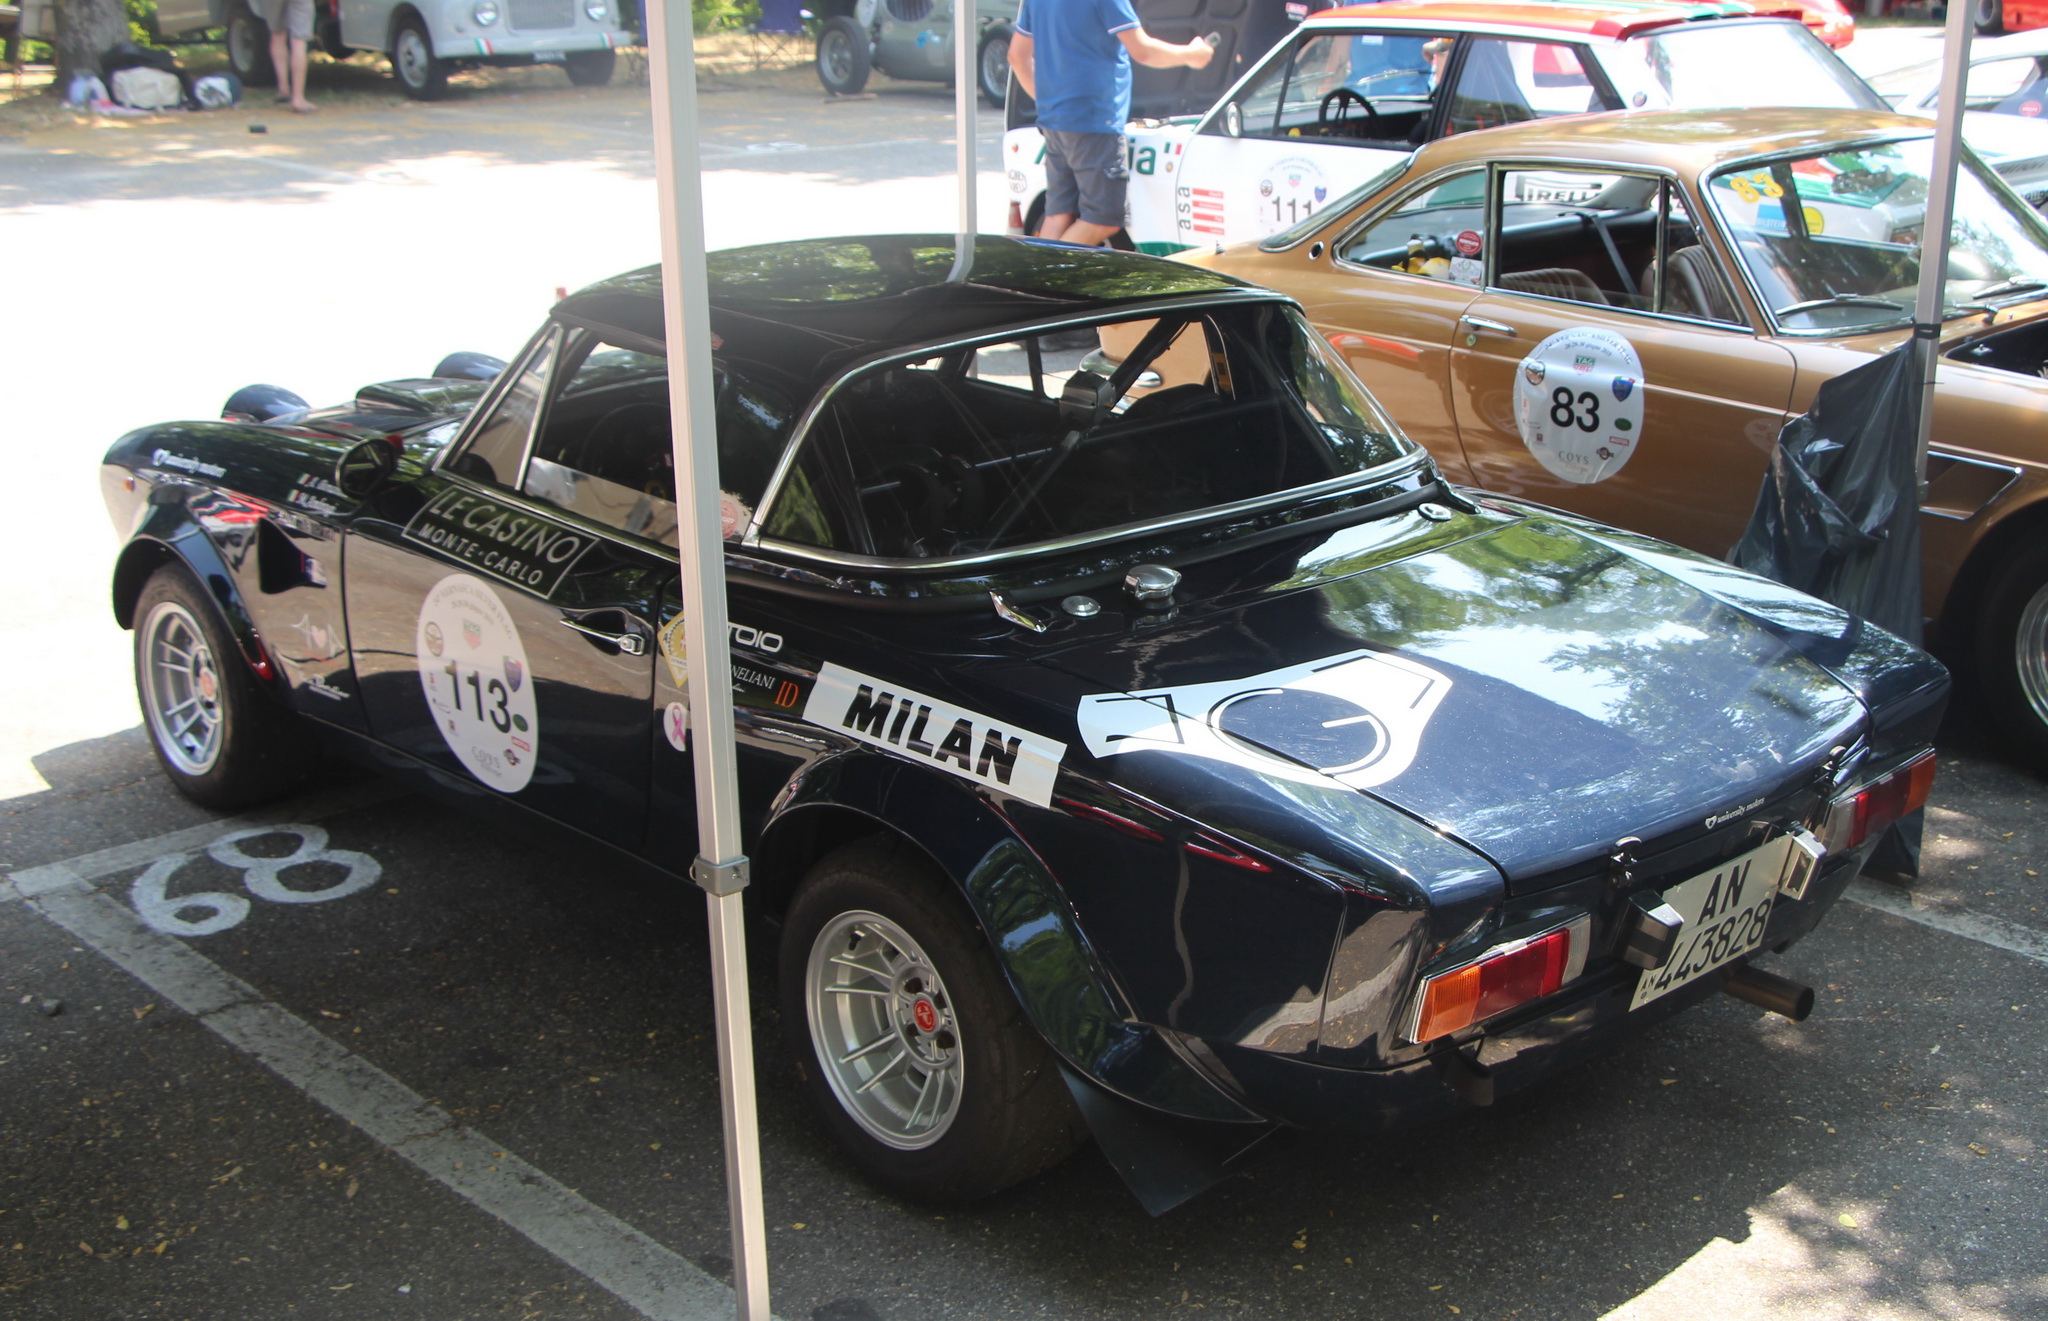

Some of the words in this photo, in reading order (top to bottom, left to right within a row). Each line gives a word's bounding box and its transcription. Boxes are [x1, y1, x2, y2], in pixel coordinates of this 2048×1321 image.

[1271, 196, 1312, 224] 111
[1730, 172, 1784, 203] 83
[1577, 357, 1594, 366] TAG
[1550, 386, 1600, 433] 83
[1558, 450, 1589, 466] COYS
[427, 490, 476, 521] LE
[462, 504, 581, 564] CASINO
[727, 621, 784, 653] TOIO
[444, 658, 512, 734] 113
[729, 664, 776, 690] NELIANI
[774, 680, 800, 709] ID
[841, 683, 1023, 786] MILAN
[130, 822, 384, 937] 68
[1697, 858, 1753, 927] AN
[1653, 898, 1773, 990] 443828
